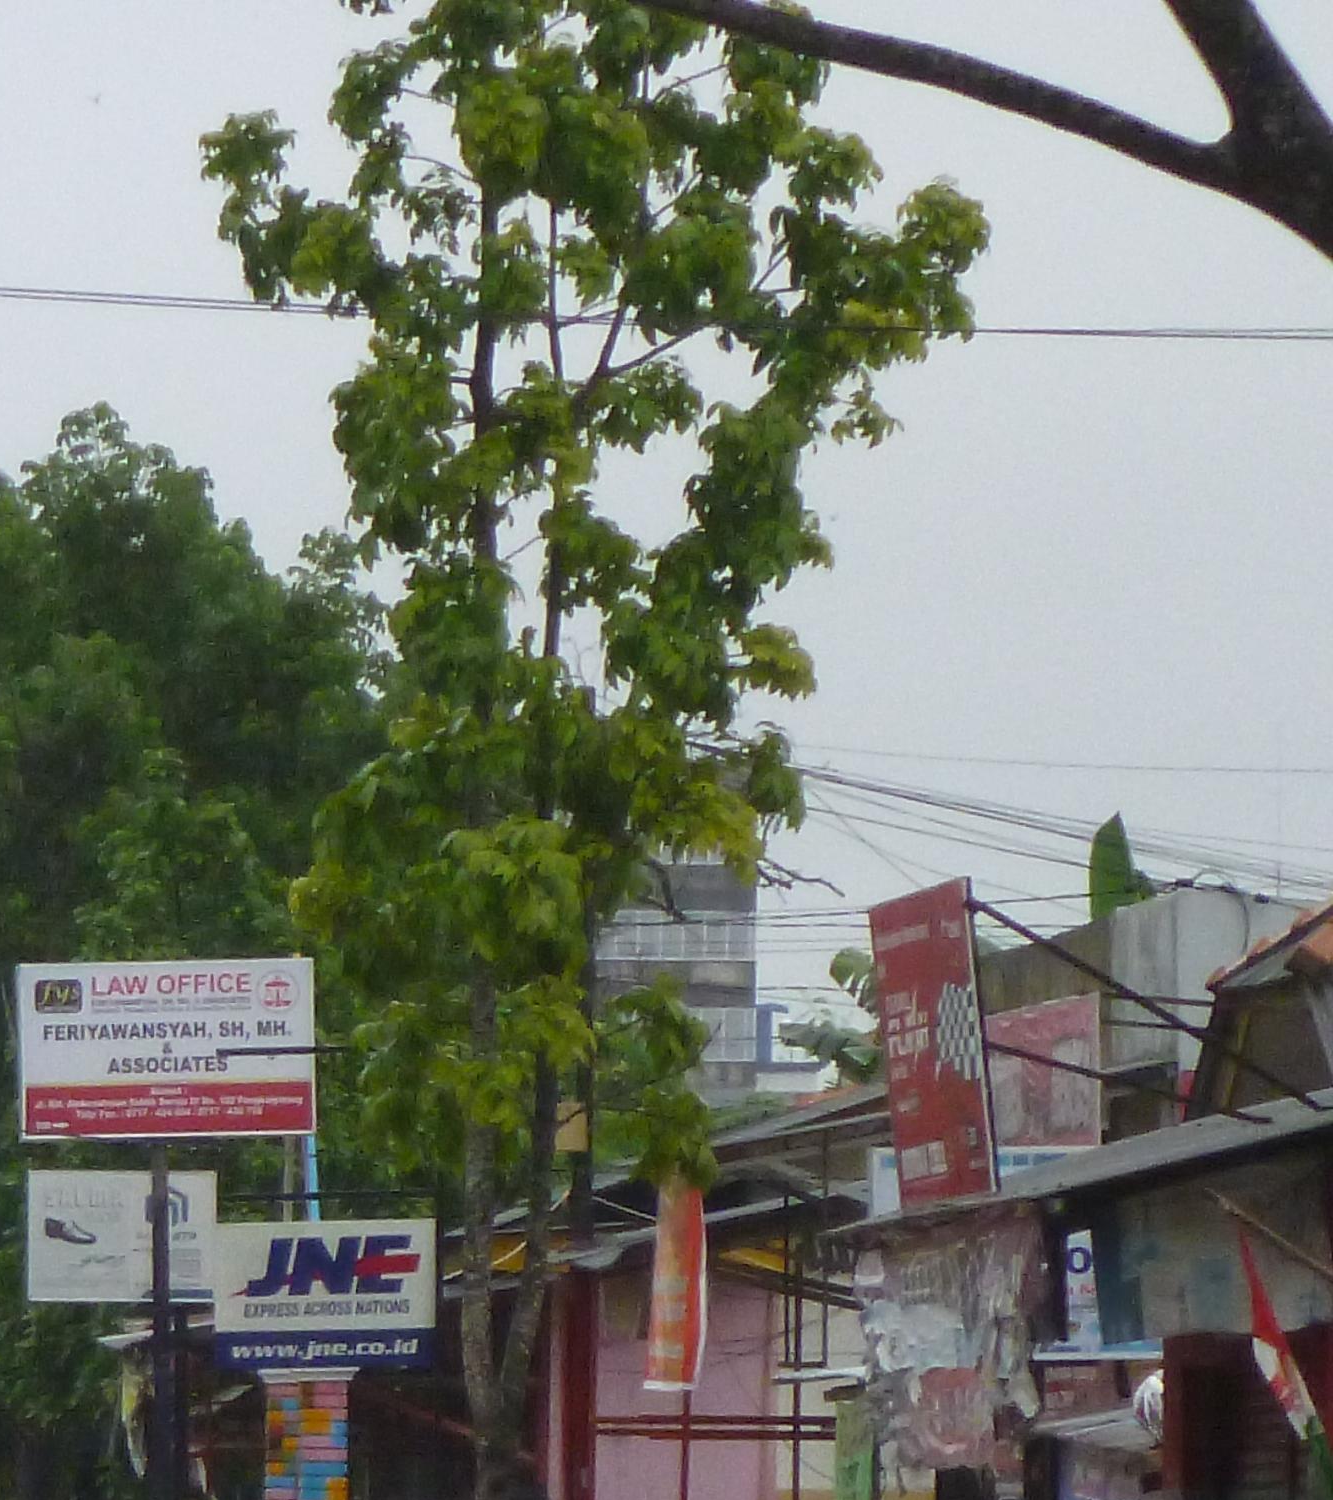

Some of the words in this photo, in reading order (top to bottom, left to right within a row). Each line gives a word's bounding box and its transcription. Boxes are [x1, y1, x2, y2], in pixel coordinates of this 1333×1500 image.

[91, 976, 147, 996] LAW
[157, 974, 252, 994] OFFICE
[44, 1021, 213, 1042] FERIYAWANSYAH,
[219, 1021, 251, 1041] SH,
[257, 1020, 291, 1037] MH.
[107, 1055, 229, 1074] ASSOCIATES
[231, 1234, 421, 1297] JNE
[244, 1301, 299, 1319] EXPRESS
[303, 1300, 353, 1316] ACROSS
[355, 1298, 410, 1315] NATIONS
[232, 1338, 419, 1361] www.jne.co.id
